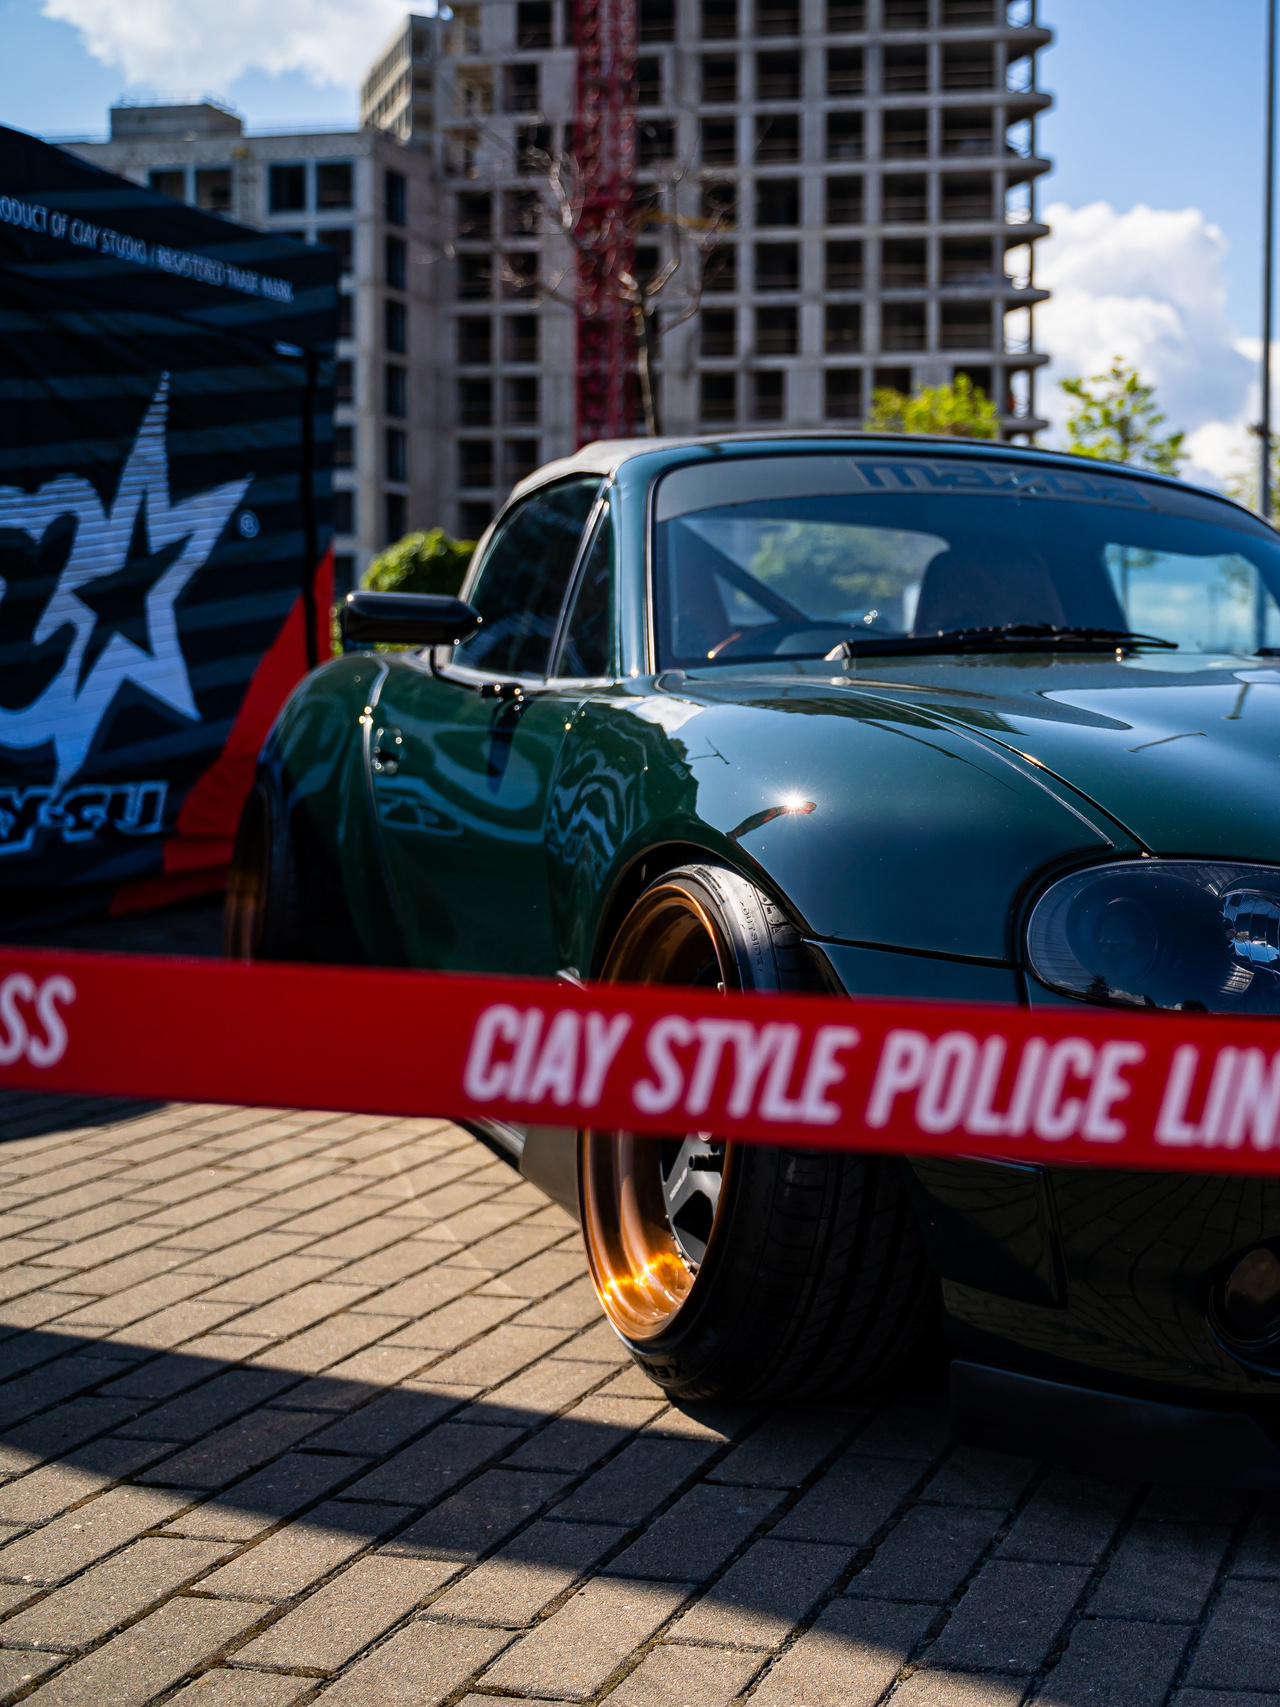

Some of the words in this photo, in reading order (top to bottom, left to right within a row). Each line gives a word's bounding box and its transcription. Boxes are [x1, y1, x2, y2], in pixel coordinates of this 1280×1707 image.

[49, 210, 70, 239] OF
[69, 218, 101, 250] CIAY
[100, 228, 147, 265] STUDIO
[156, 245, 226, 287] REGISTERED
[225, 263, 261, 297] TRADE
[261, 274, 295, 304] MARK
[463, 1004, 633, 1107] CIAY
[632, 1015, 861, 1126] STYLE
[865, 1028, 1146, 1143] POLICE
